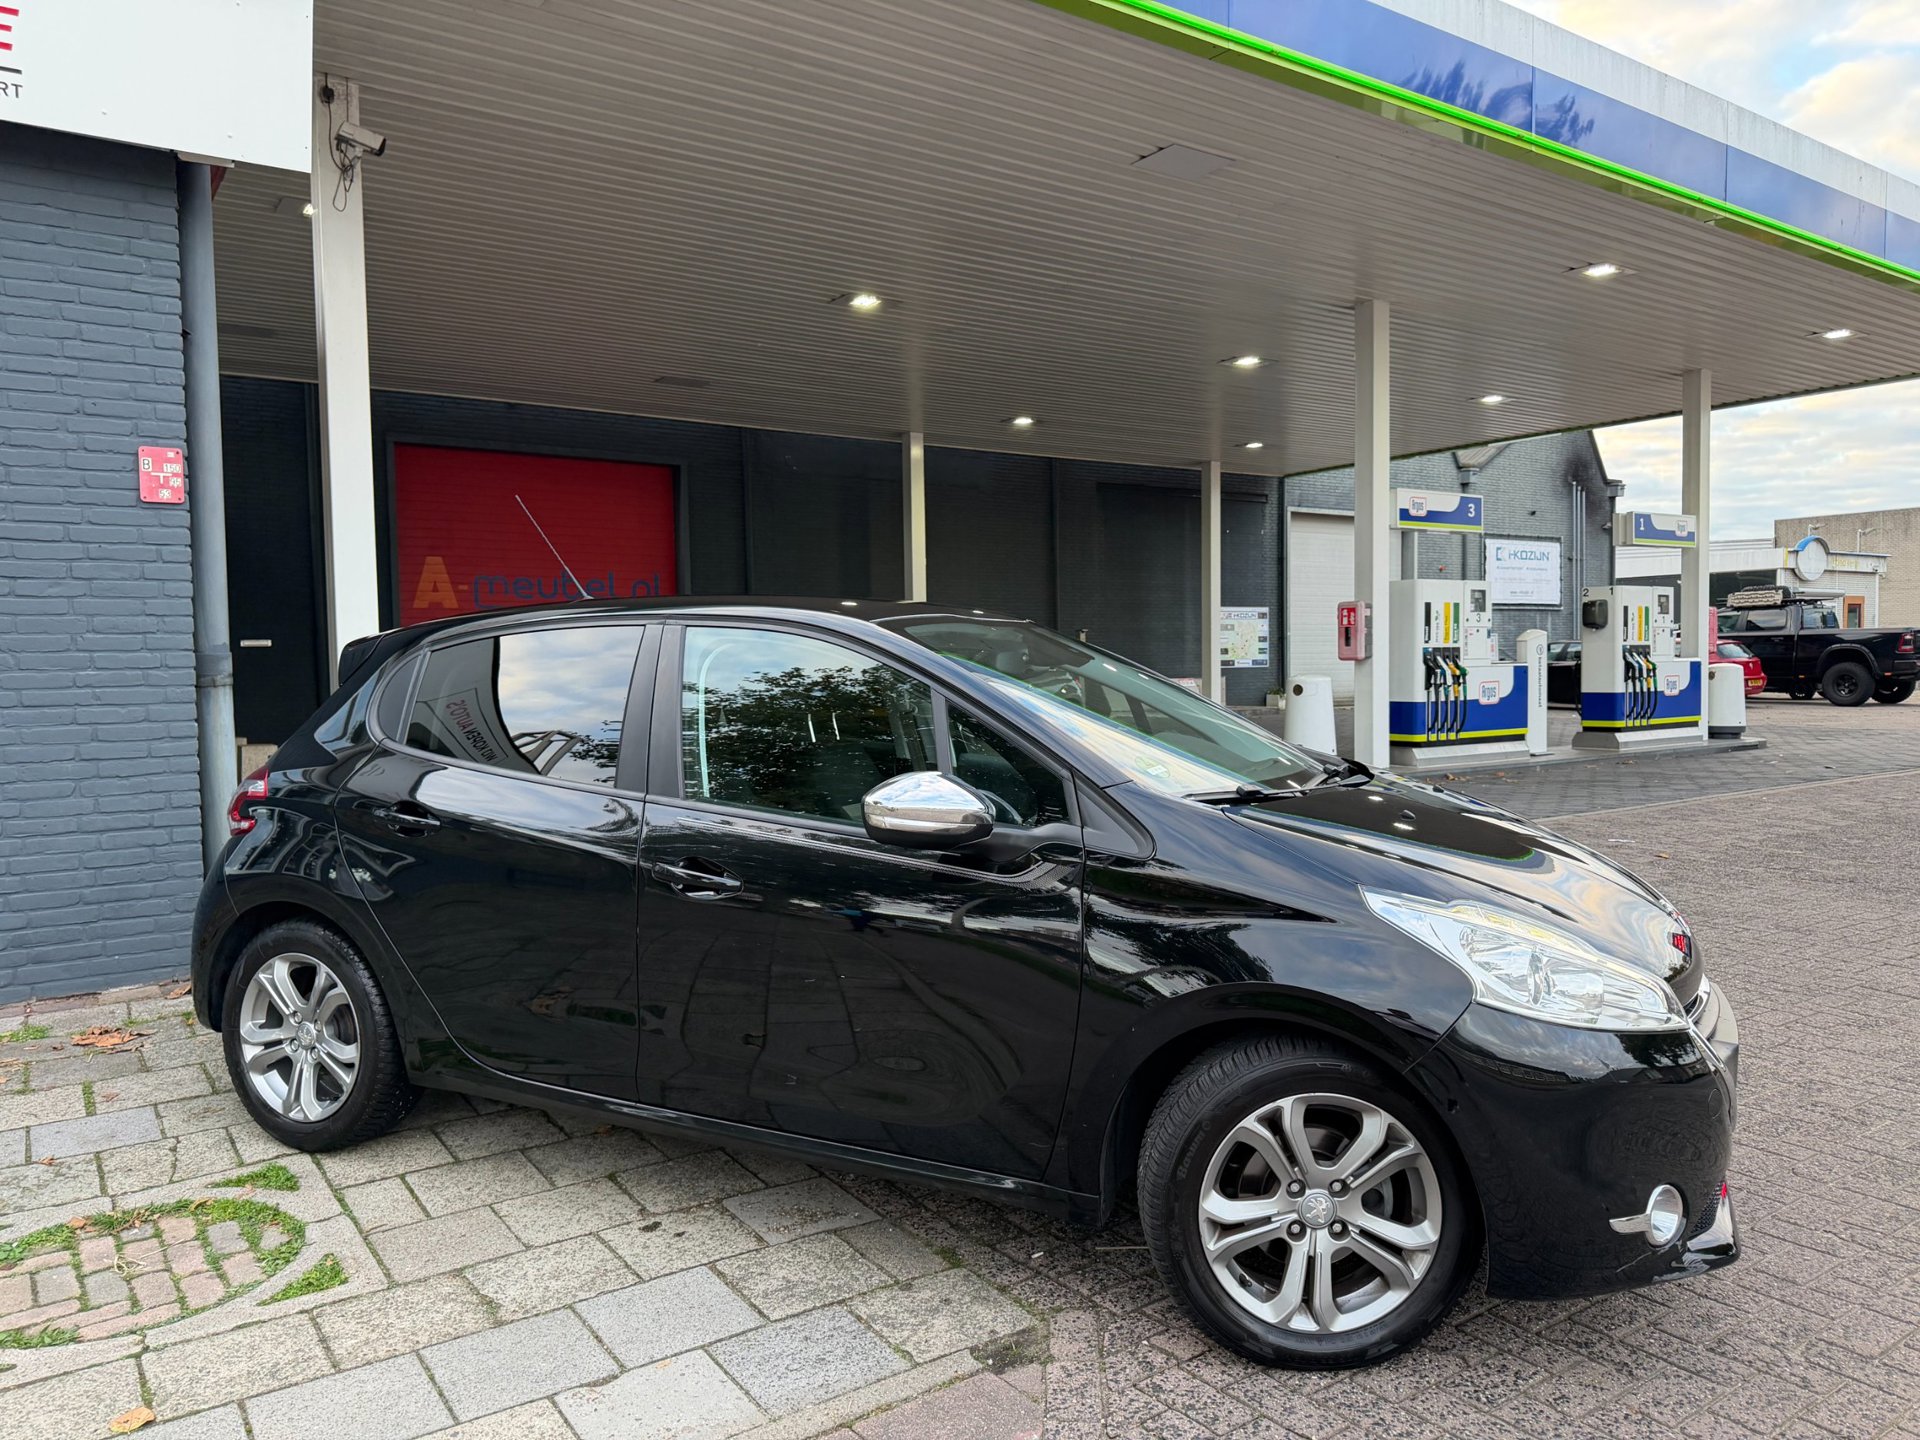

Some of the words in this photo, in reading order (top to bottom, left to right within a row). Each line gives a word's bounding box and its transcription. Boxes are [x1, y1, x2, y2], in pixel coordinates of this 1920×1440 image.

[143, 458, 151, 470] B
[1467, 503, 1475, 518] 3
[1639, 518, 1645, 531] 1
[413, 556, 661, 609] A-meubelnl
[1582, 588, 1590, 597] 2
[1609, 587, 1614, 596] 1
[1476, 613, 1482, 623] 3
